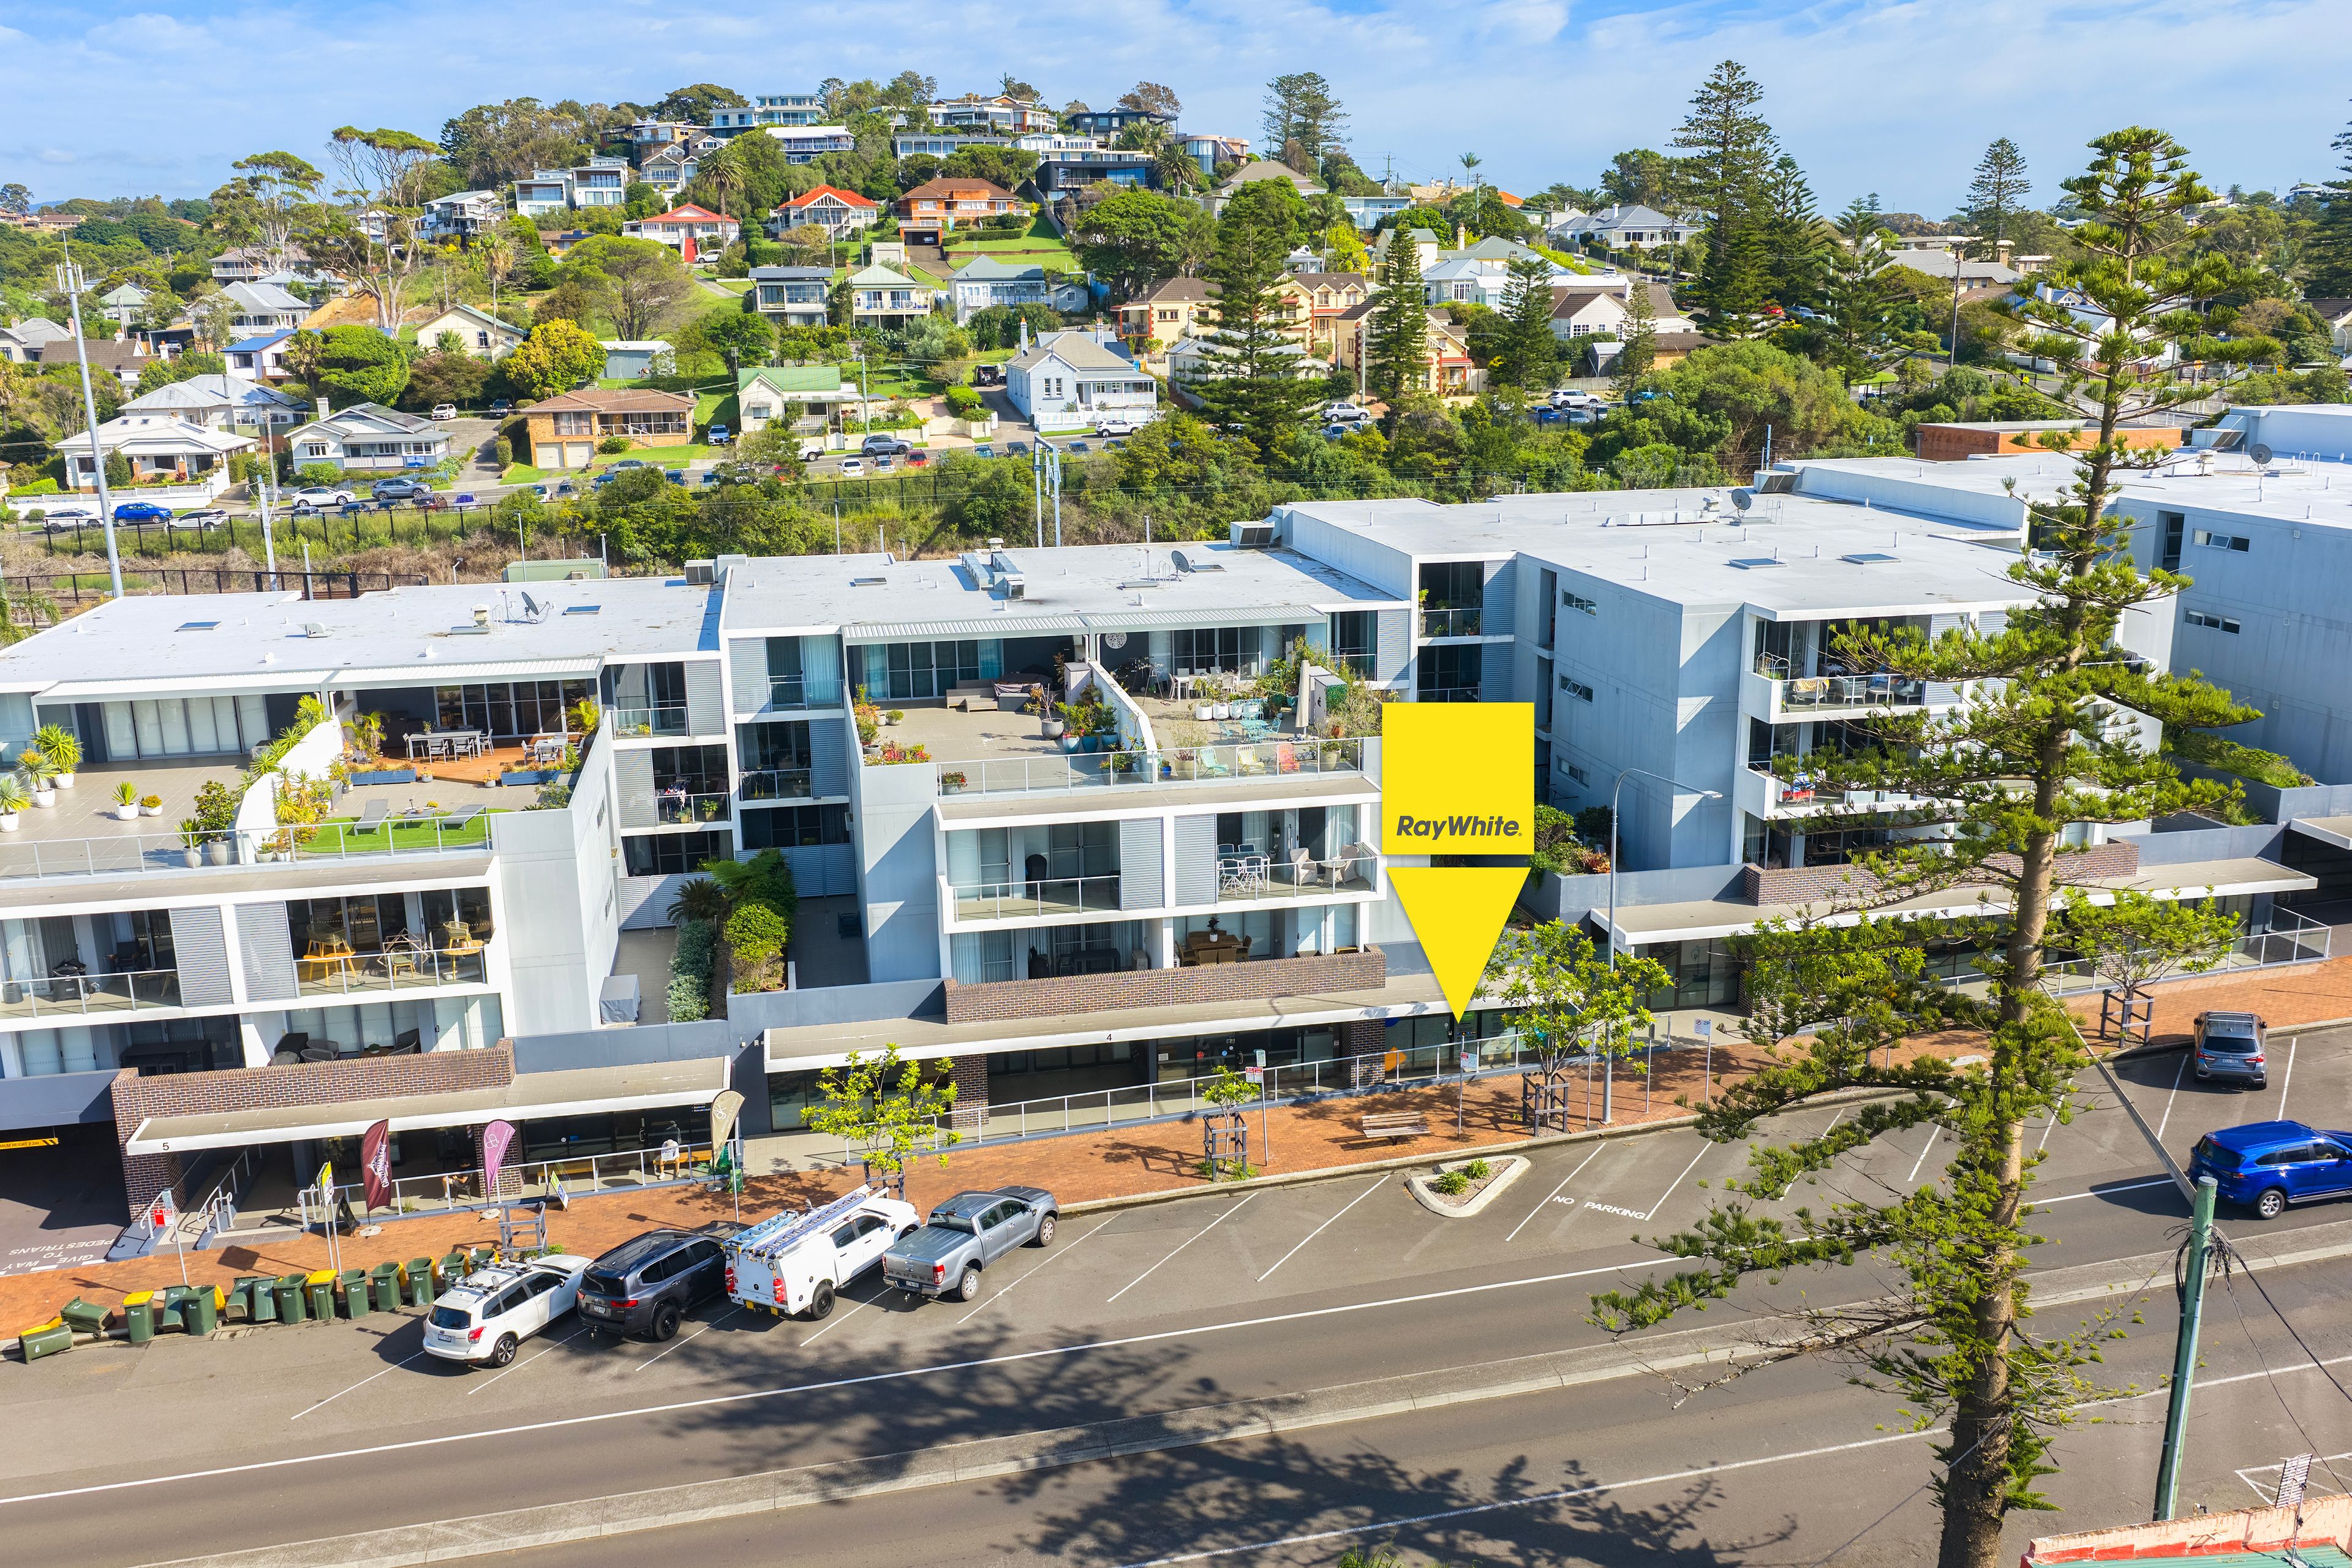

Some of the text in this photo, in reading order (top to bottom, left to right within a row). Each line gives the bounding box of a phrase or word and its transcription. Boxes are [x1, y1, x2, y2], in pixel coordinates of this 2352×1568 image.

[162, 1142, 170, 1151] 5
[1552, 1195, 1646, 1219] NO PARKING
[9, 1238, 116, 1255] PEDESTRIANS
[2, 1254, 94, 1270] GIVE WAY
[888, 1269, 934, 1282] RANGER
